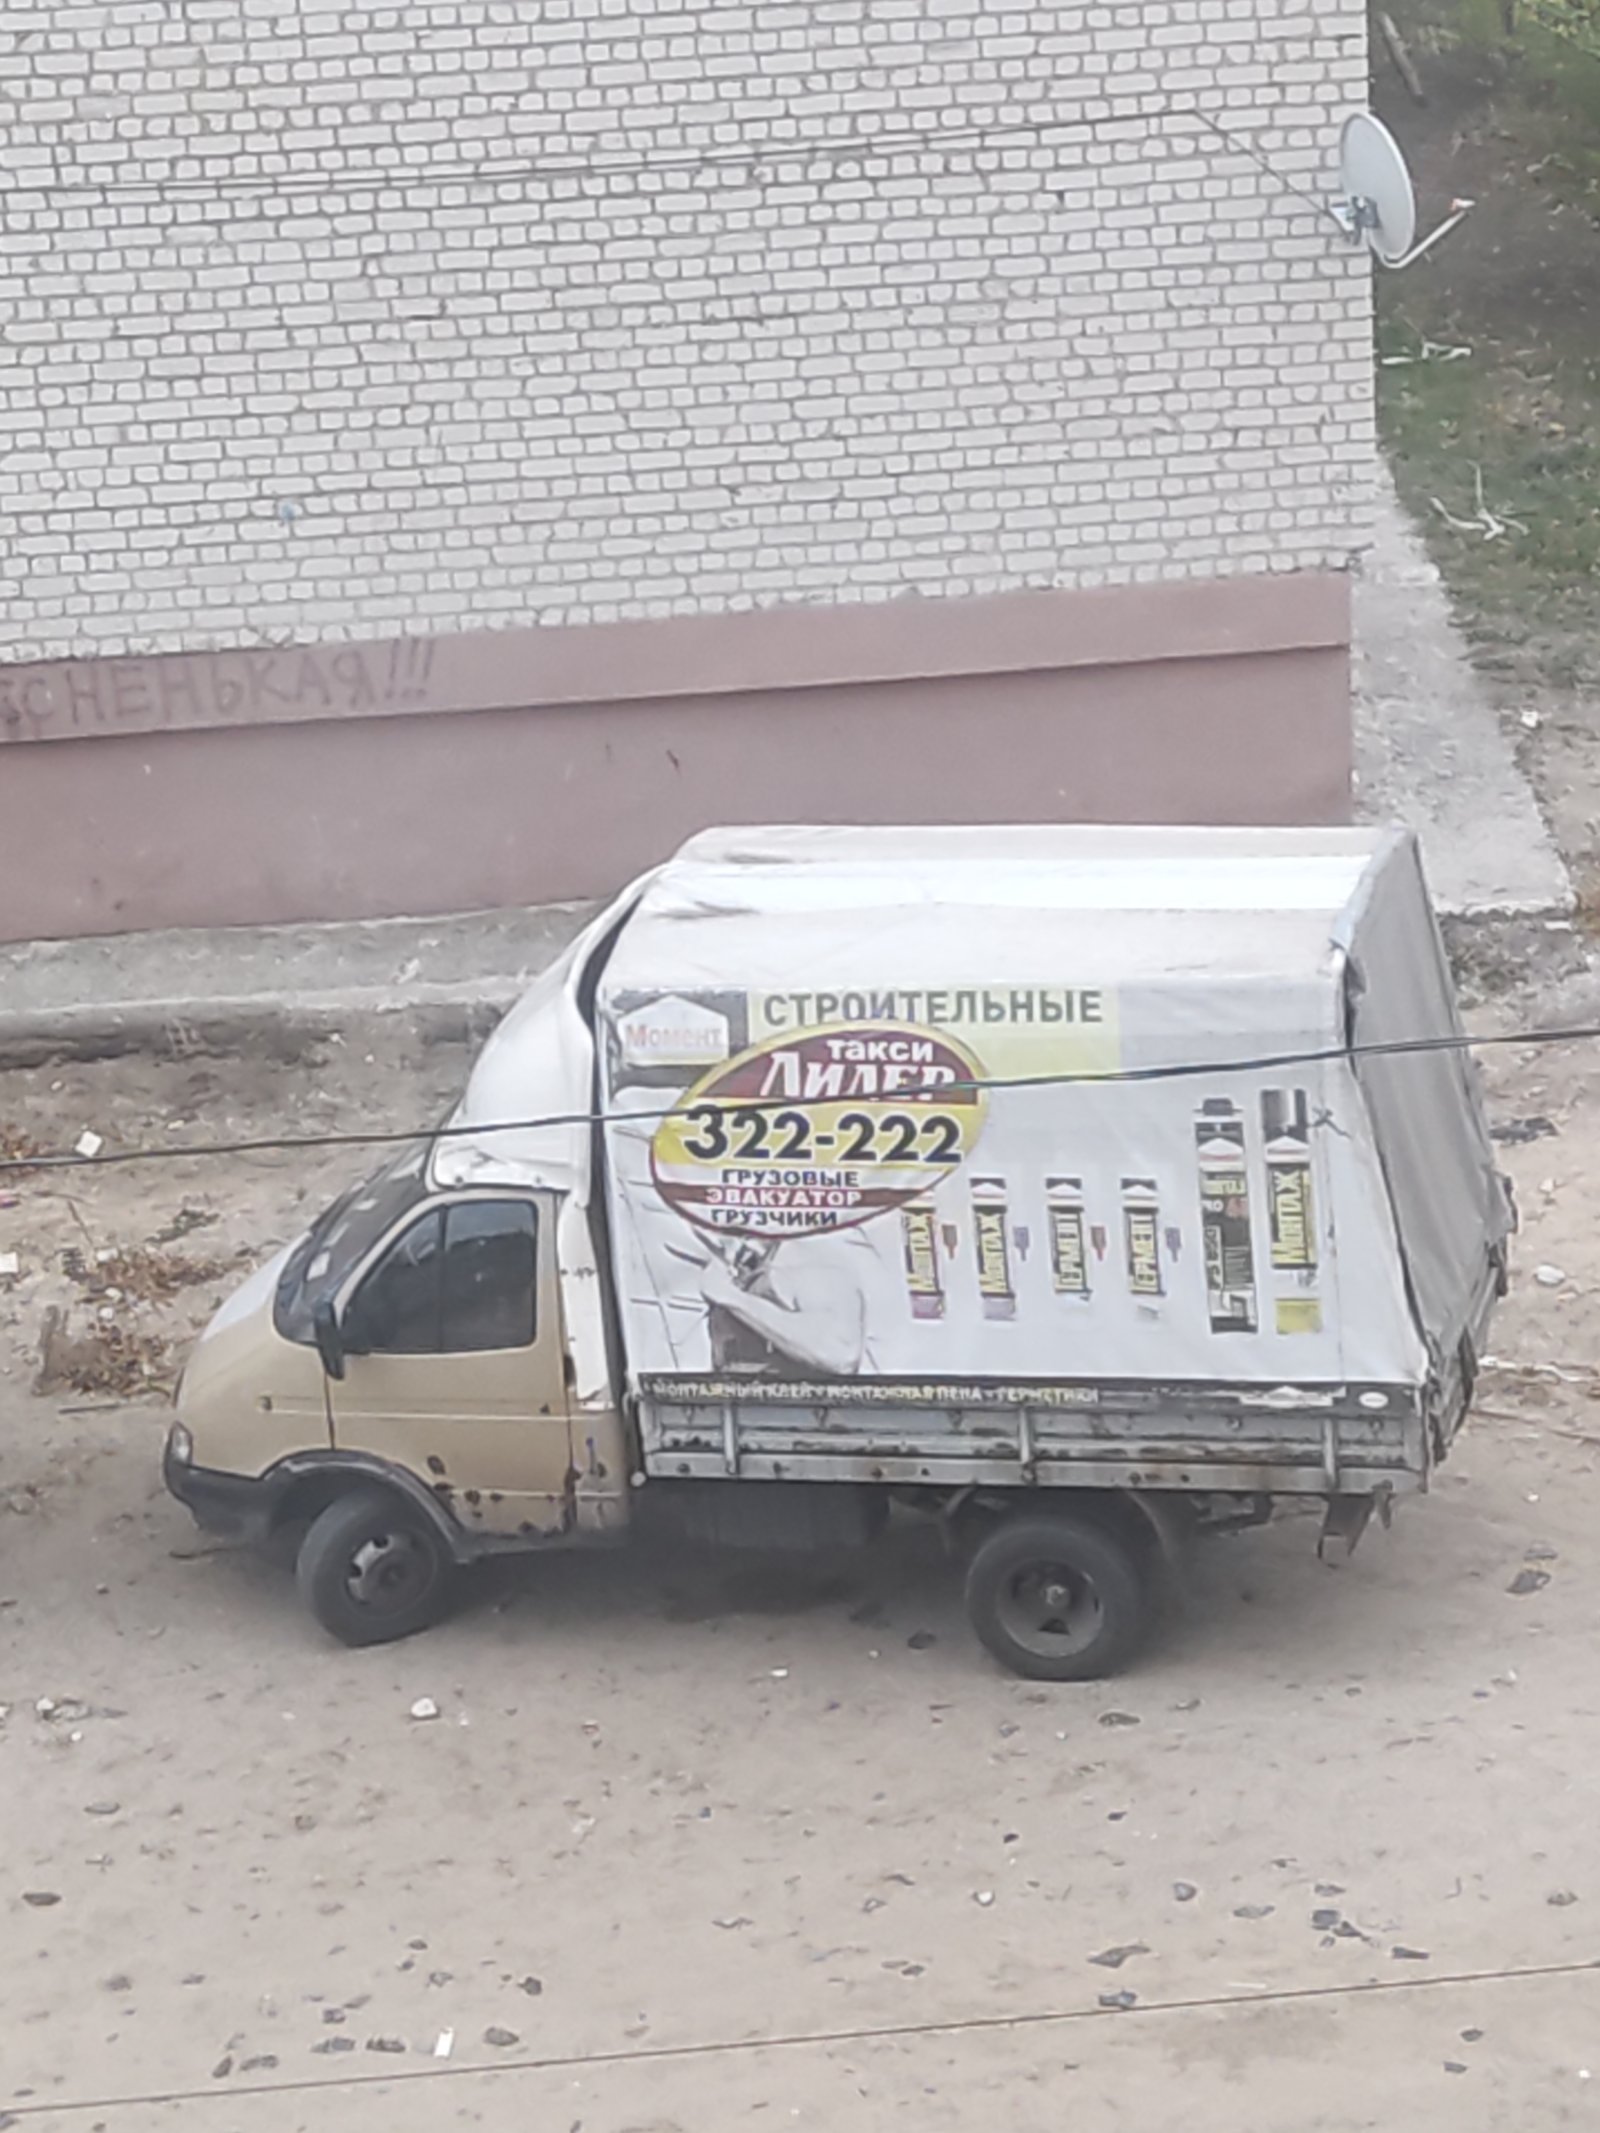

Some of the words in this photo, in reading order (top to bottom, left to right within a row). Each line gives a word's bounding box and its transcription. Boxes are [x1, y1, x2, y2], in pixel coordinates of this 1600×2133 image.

[763, 990, 1103, 1026] СТРОИТЕЛЬНЫЕ
[826, 1039, 933, 1062] такси
[683, 1104, 962, 1164] 322-222
[721, 1169, 860, 1187] ГРУЗОВЫЕ
[705, 1187, 862, 1207] ЭВАКУАТОР
[711, 1208, 838, 1226] ГРУЗЧИКИ
